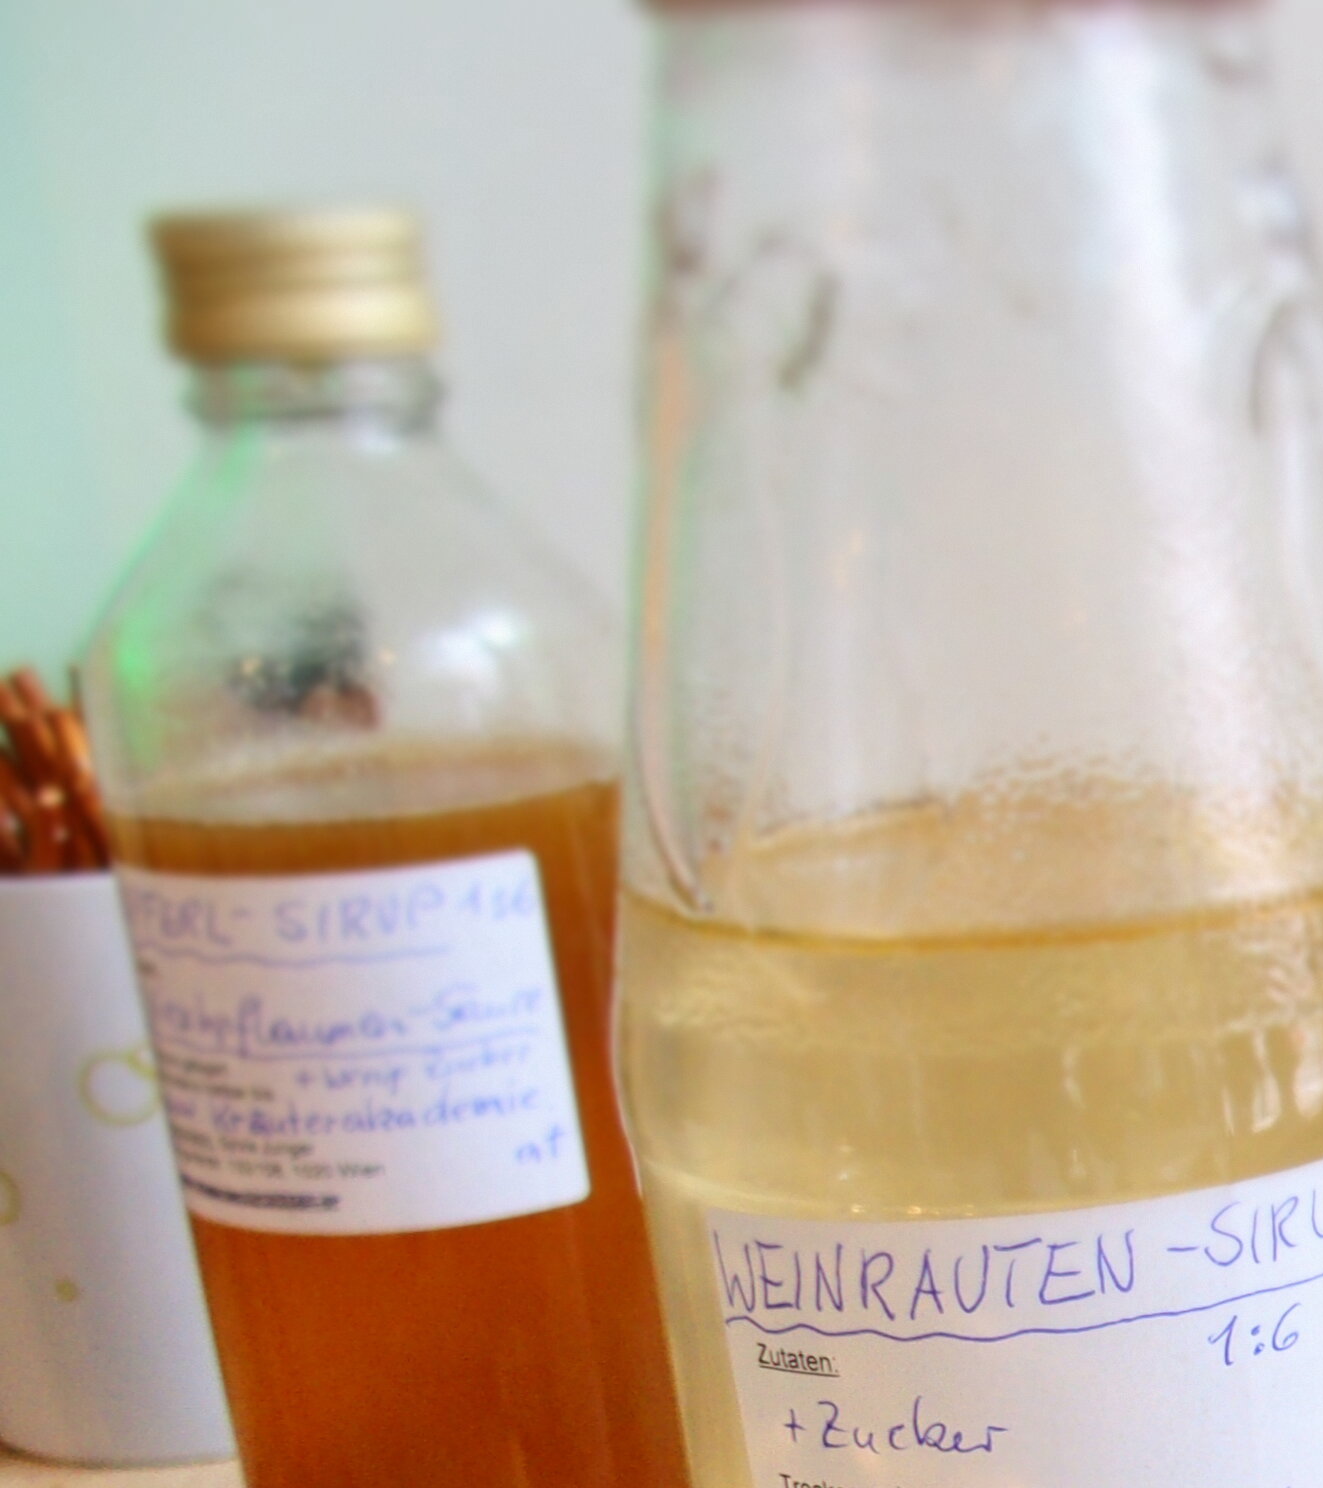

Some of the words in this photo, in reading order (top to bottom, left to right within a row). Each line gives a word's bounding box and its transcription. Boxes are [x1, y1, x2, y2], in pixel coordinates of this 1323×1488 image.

[713, 1229, 1135, 1322] WEINRAUTEN
[756, 1342, 840, 1378] Zutaten:
[1207, 1301, 1302, 1367] 1:6
